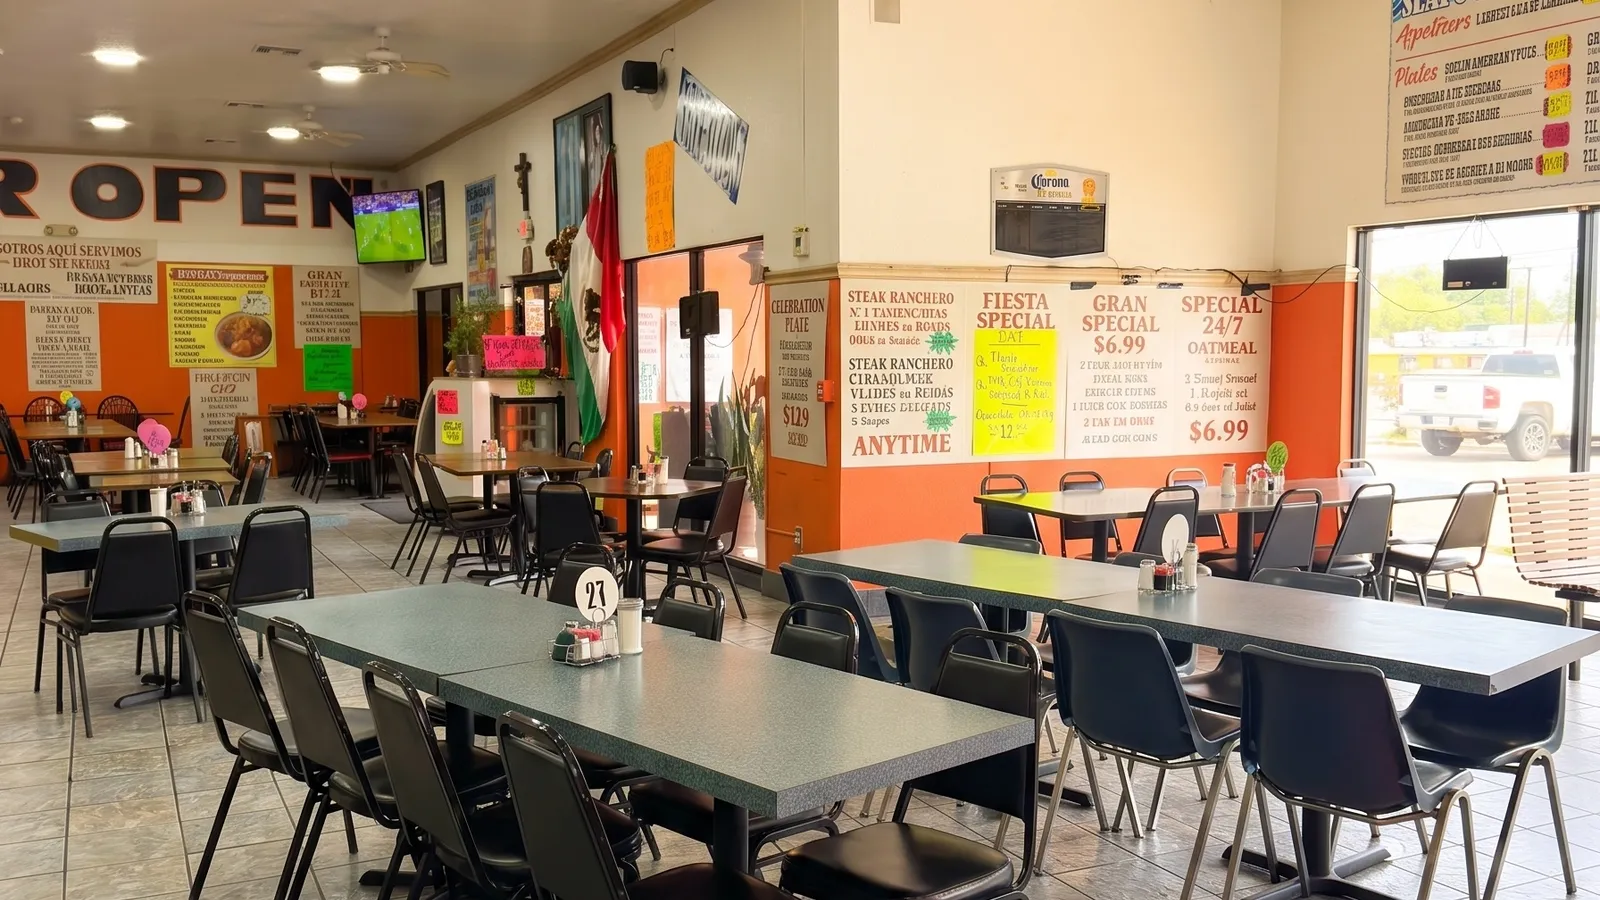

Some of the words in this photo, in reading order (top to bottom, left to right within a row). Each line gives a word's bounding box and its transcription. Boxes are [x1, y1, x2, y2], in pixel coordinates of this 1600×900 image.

[1394, 63, 1439, 88] Plates
[1031, 174, 1069, 190] Corona
[70, 162, 373, 231] OPEN
[79, 245, 141, 258] SERVIMOS
[307, 270, 342, 280] GRAN
[771, 298, 825, 315] CELEBRATION
[848, 290, 887, 304] STEAK
[890, 291, 954, 305] RANCHERO
[982, 292, 1049, 310] FIESTA
[1093, 294, 1147, 312] GRAN
[1181, 295, 1263, 314] SPECIAL
[785, 317, 809, 333] PLATE
[977, 313, 1056, 329] SPECIAL
[1082, 315, 1160, 333] SPECIAL
[1202, 315, 1243, 338] 24/7
[1094, 335, 1146, 355] $6.99
[1188, 341, 1257, 355] OATMEAL
[849, 358, 887, 371] STEAK
[890, 358, 954, 370] RANCHERO
[1190, 419, 1249, 444] $6.99
[852, 433, 952, 456] ANYTIME
[585, 580, 606, 609] 27
